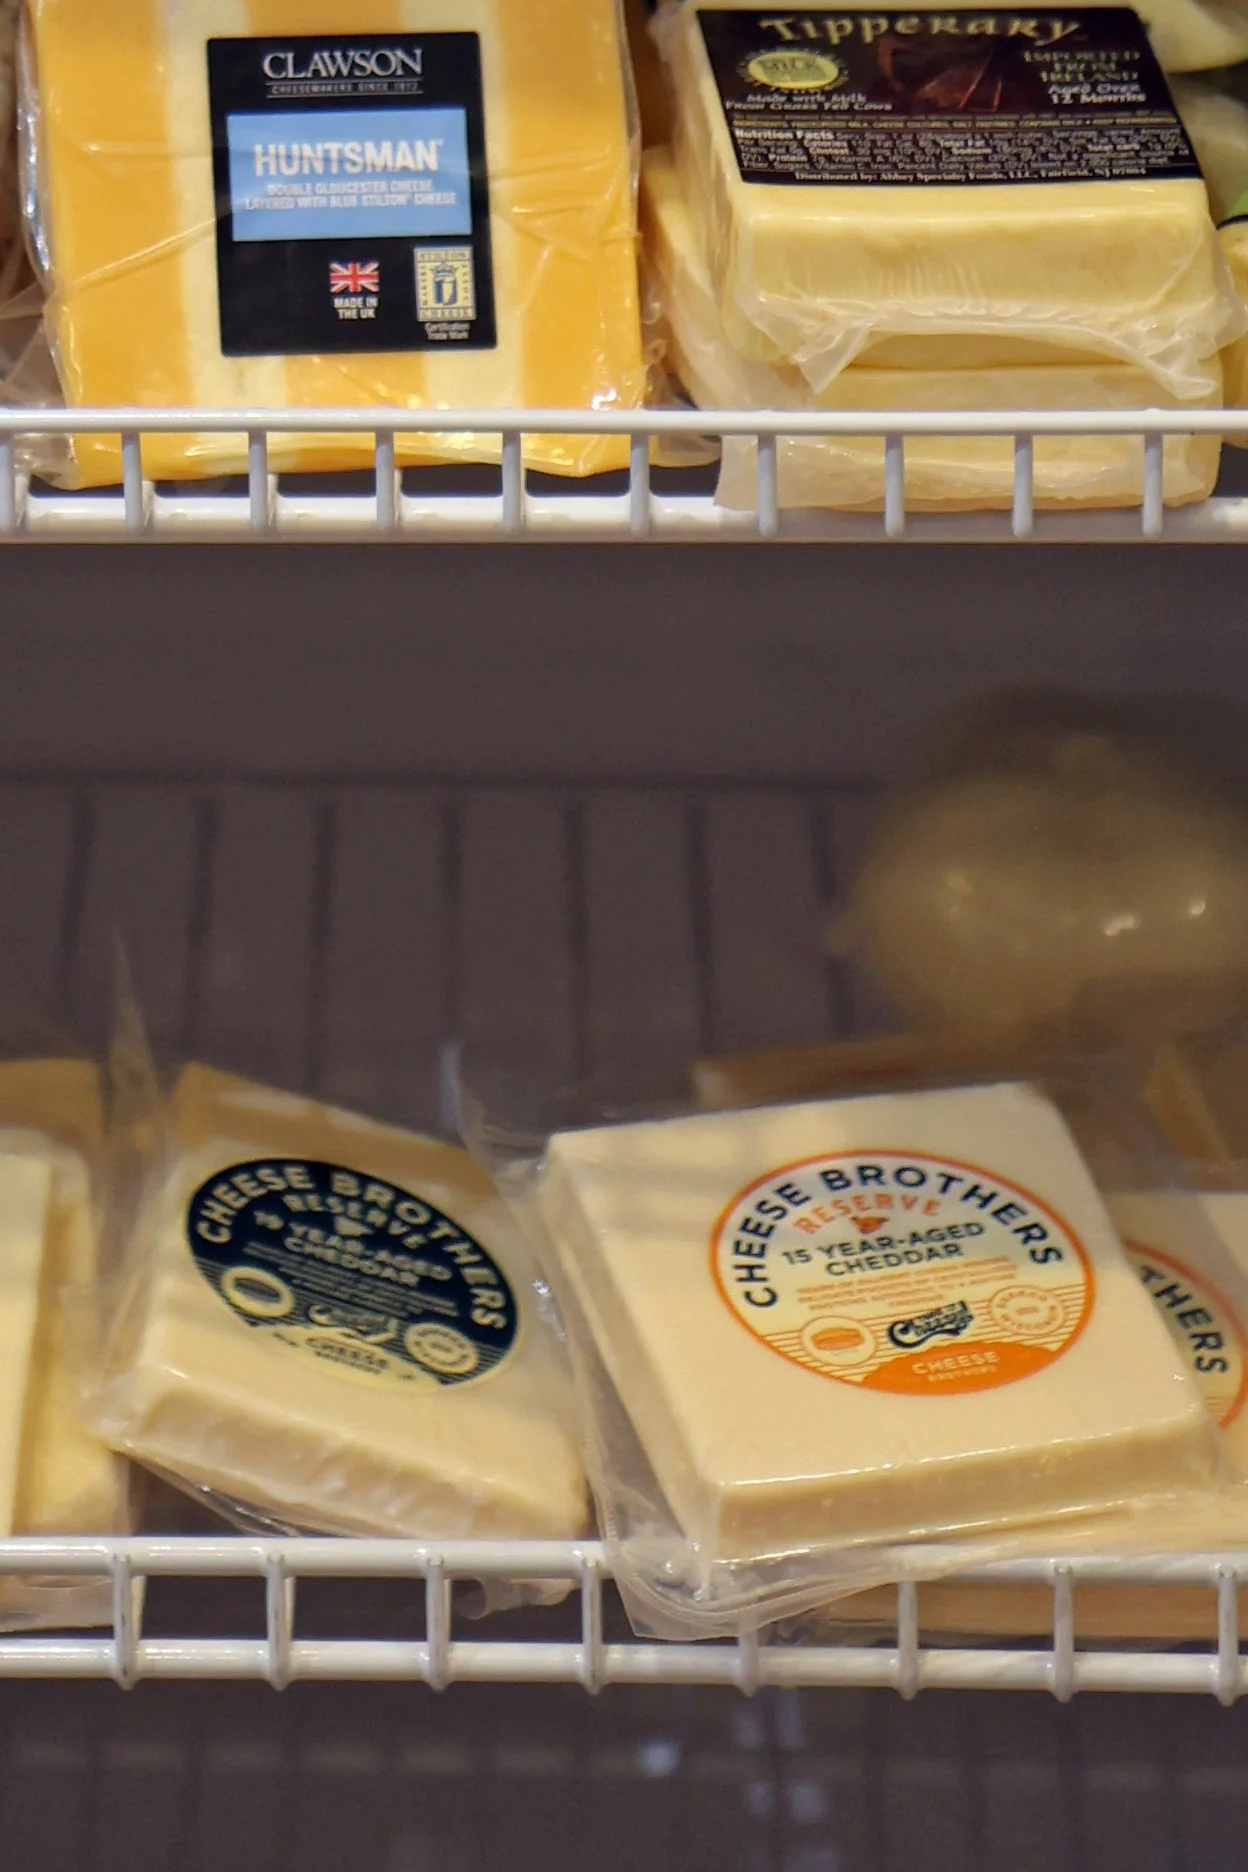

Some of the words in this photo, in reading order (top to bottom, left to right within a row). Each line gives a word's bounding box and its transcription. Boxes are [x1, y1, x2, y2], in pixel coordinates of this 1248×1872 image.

[263, 49, 424, 80] CLAWSON
[253, 139, 440, 178] HUNTSMAN
[334, 297, 364, 309] MADE
[367, 297, 378, 308] IN
[337, 309, 357, 319] THE
[359, 308, 375, 319] UK
[793, 1192, 942, 1235] RESERVE
[197, 1165, 316, 1245] CHEESE
[331, 1171, 508, 1330] BROTHERS
[732, 1181, 812, 1309] CHEESE
[818, 1163, 1064, 1265] BROTHERS
[781, 1248, 813, 1265] 15
[817, 1220, 987, 1262] YEAR-AGED
[284, 1236, 420, 1286] CHEDDAR
[825, 1241, 965, 1278] CHEDDAR
[912, 1349, 999, 1376] CHEESE
